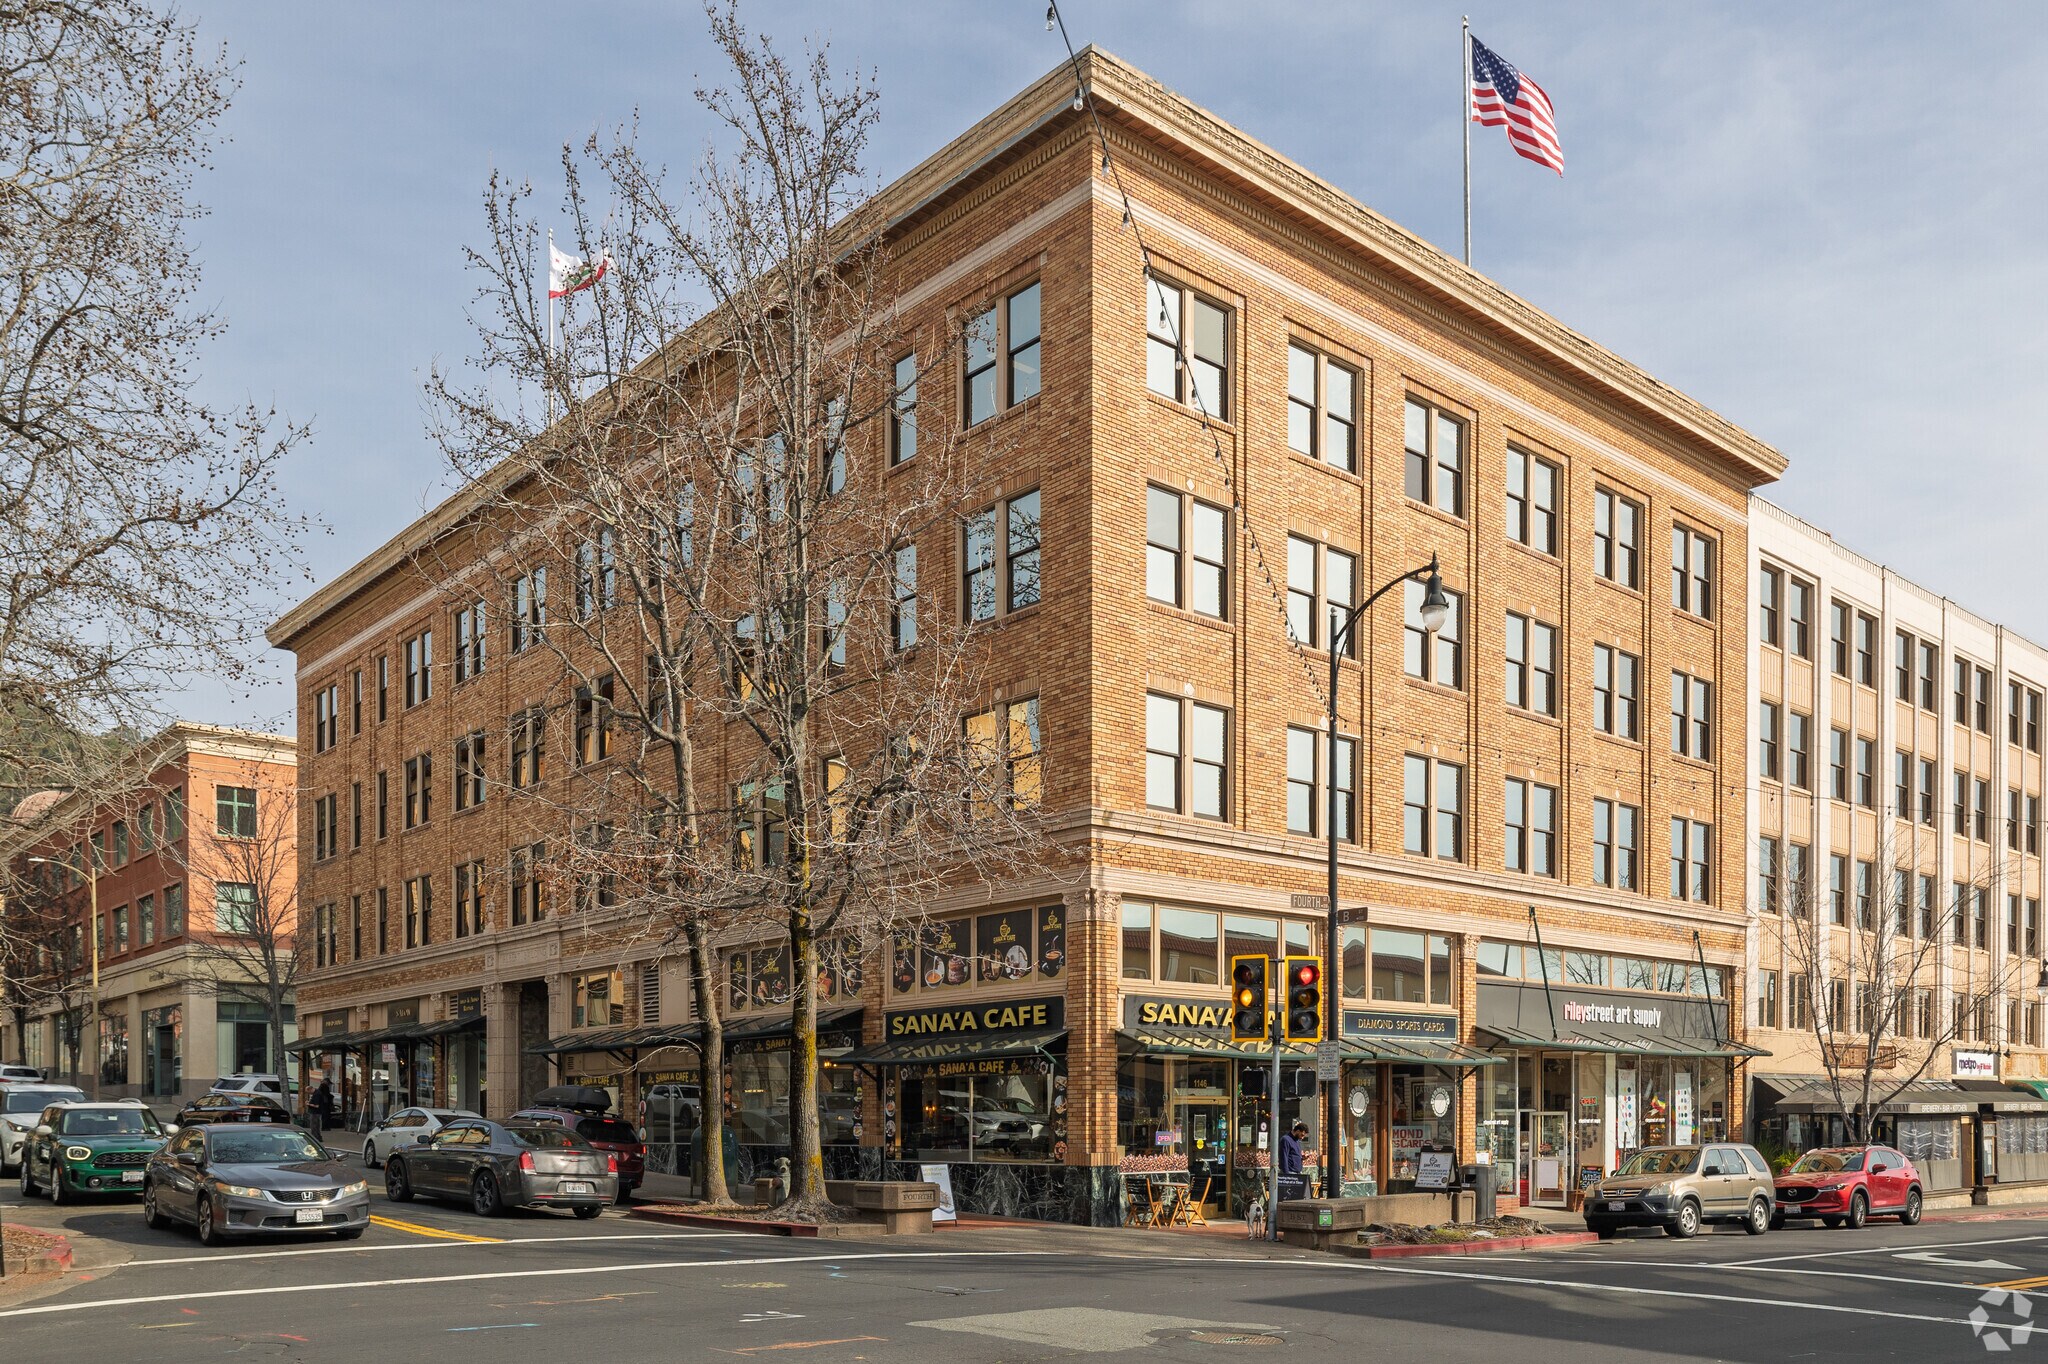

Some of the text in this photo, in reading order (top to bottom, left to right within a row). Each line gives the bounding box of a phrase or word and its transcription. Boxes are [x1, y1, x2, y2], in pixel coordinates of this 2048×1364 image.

[1293, 895, 1320, 908] FOURTH
[1343, 911, 1350, 921] B
[892, 1004, 1047, 1035] SANA'A CAFE
[1564, 1001, 1661, 1028] rileystreet art supply
[1358, 1018, 1445, 1032] DIAMOND SPORTS CARDS
[939, 1062, 975, 1076] SANA'A
[978, 1060, 1005, 1074] CAFE
[1959, 1058, 1977, 1070] metro
[676, 1072, 689, 1081] CAFE
[1193, 1079, 1208, 1088] 1146
[903, 1193, 933, 1201] FOURTH
